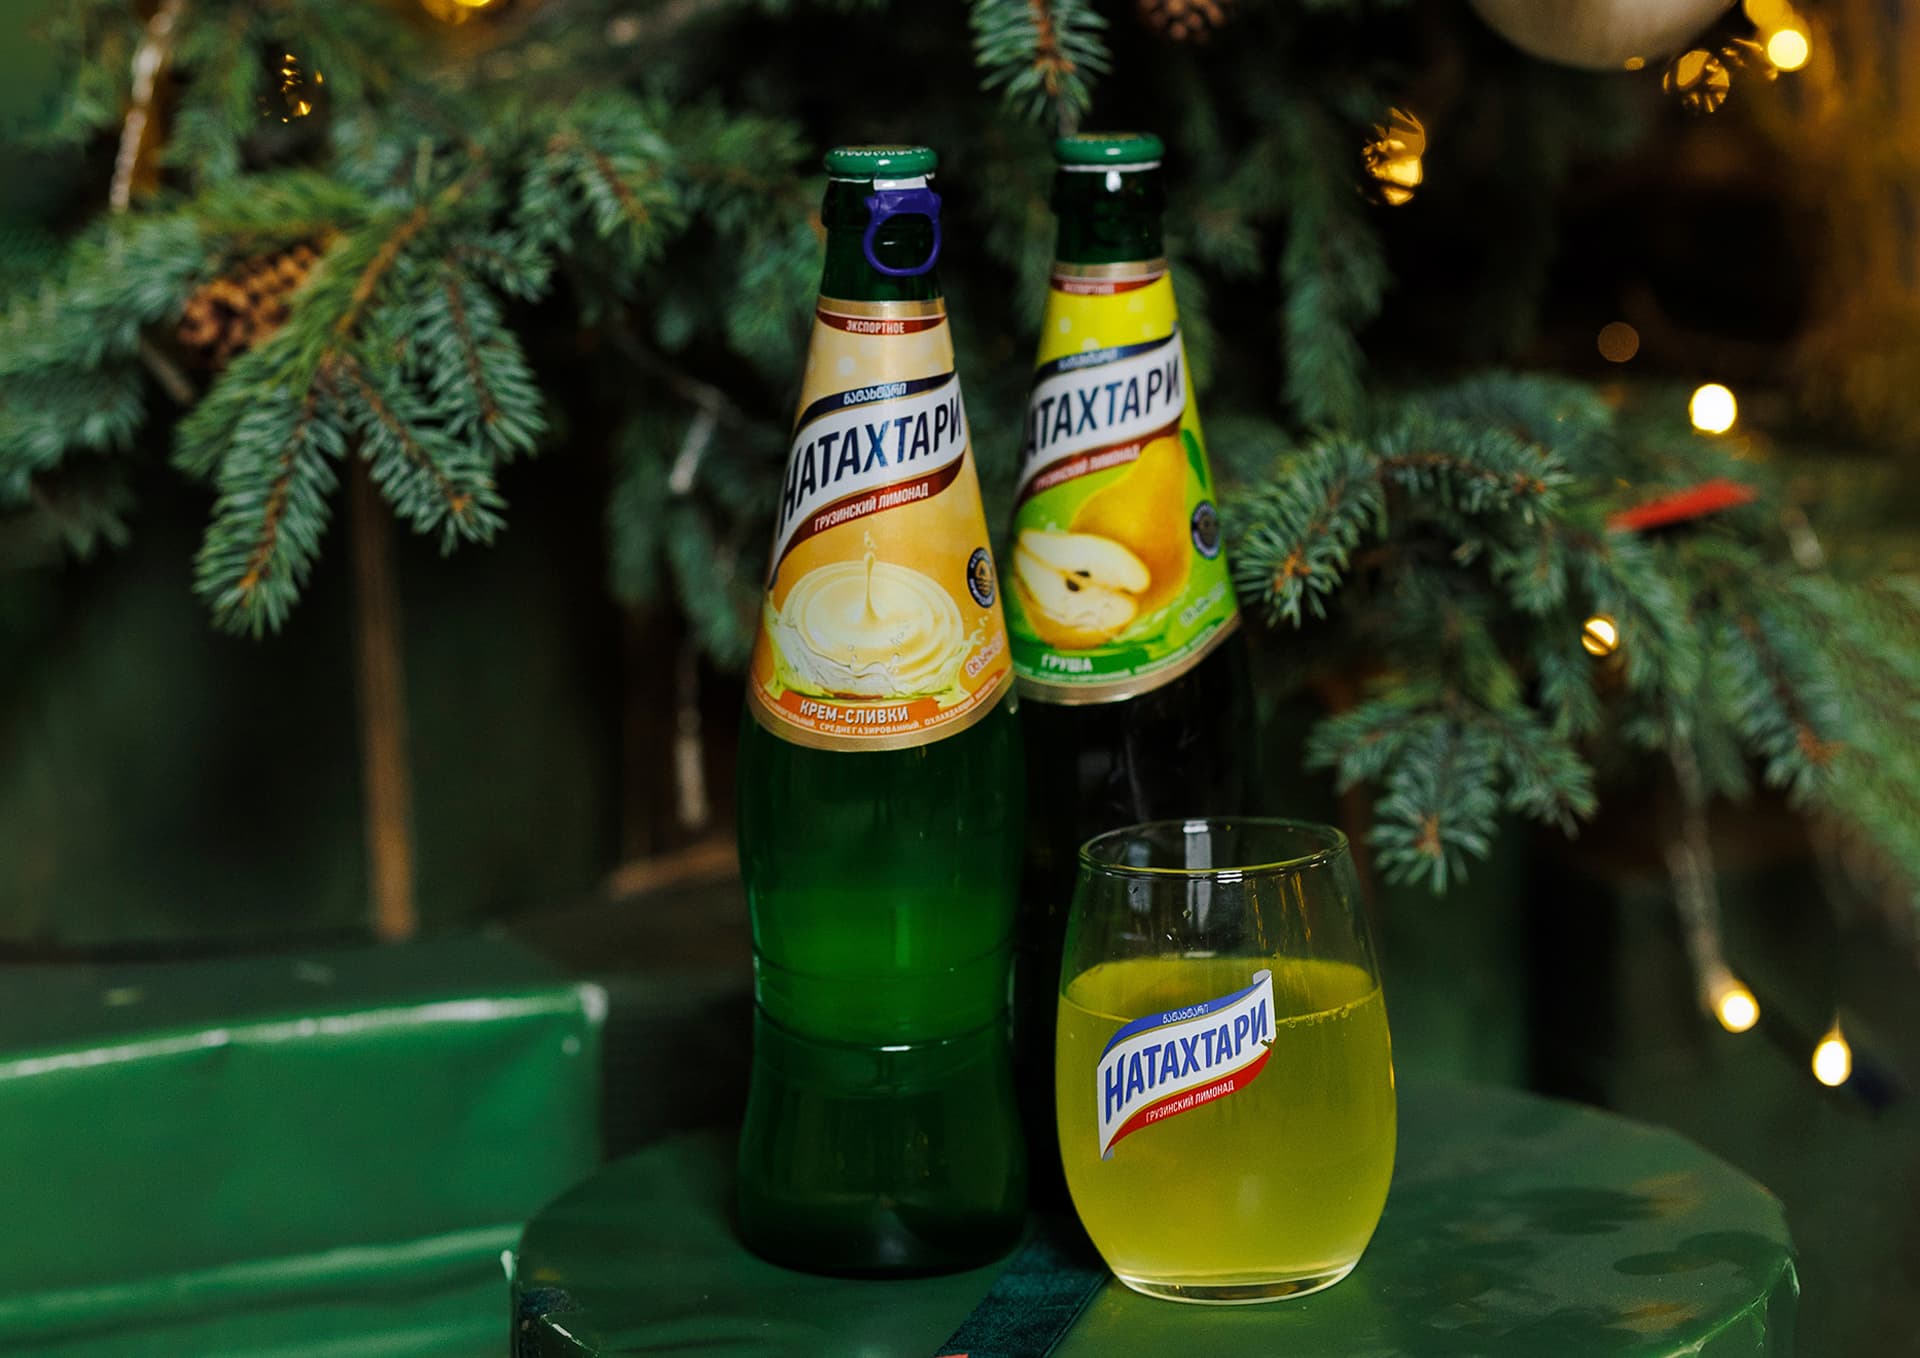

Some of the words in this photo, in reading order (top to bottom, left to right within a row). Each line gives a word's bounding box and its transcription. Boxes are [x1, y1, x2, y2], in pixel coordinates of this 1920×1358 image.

[846, 319, 905, 334] ЭКСПОРТНОЕ
[1023, 355, 1180, 458] АТАХТАРИ
[778, 392, 961, 541] НАТАХТАРИ
[814, 496, 877, 532] ГРУЗИНСКИЙ
[878, 482, 929, 508] ЛИМОНАД
[1041, 653, 1093, 673] ГРУША
[800, 700, 909, 725] КРЕМ-СЛИВКИ
[1105, 998, 1268, 1125] НАТАХТАРИ
[1146, 1095, 1194, 1123] ГРУЗИНСКИЙ
[1195, 1080, 1234, 1104] ЛИМОНАД
